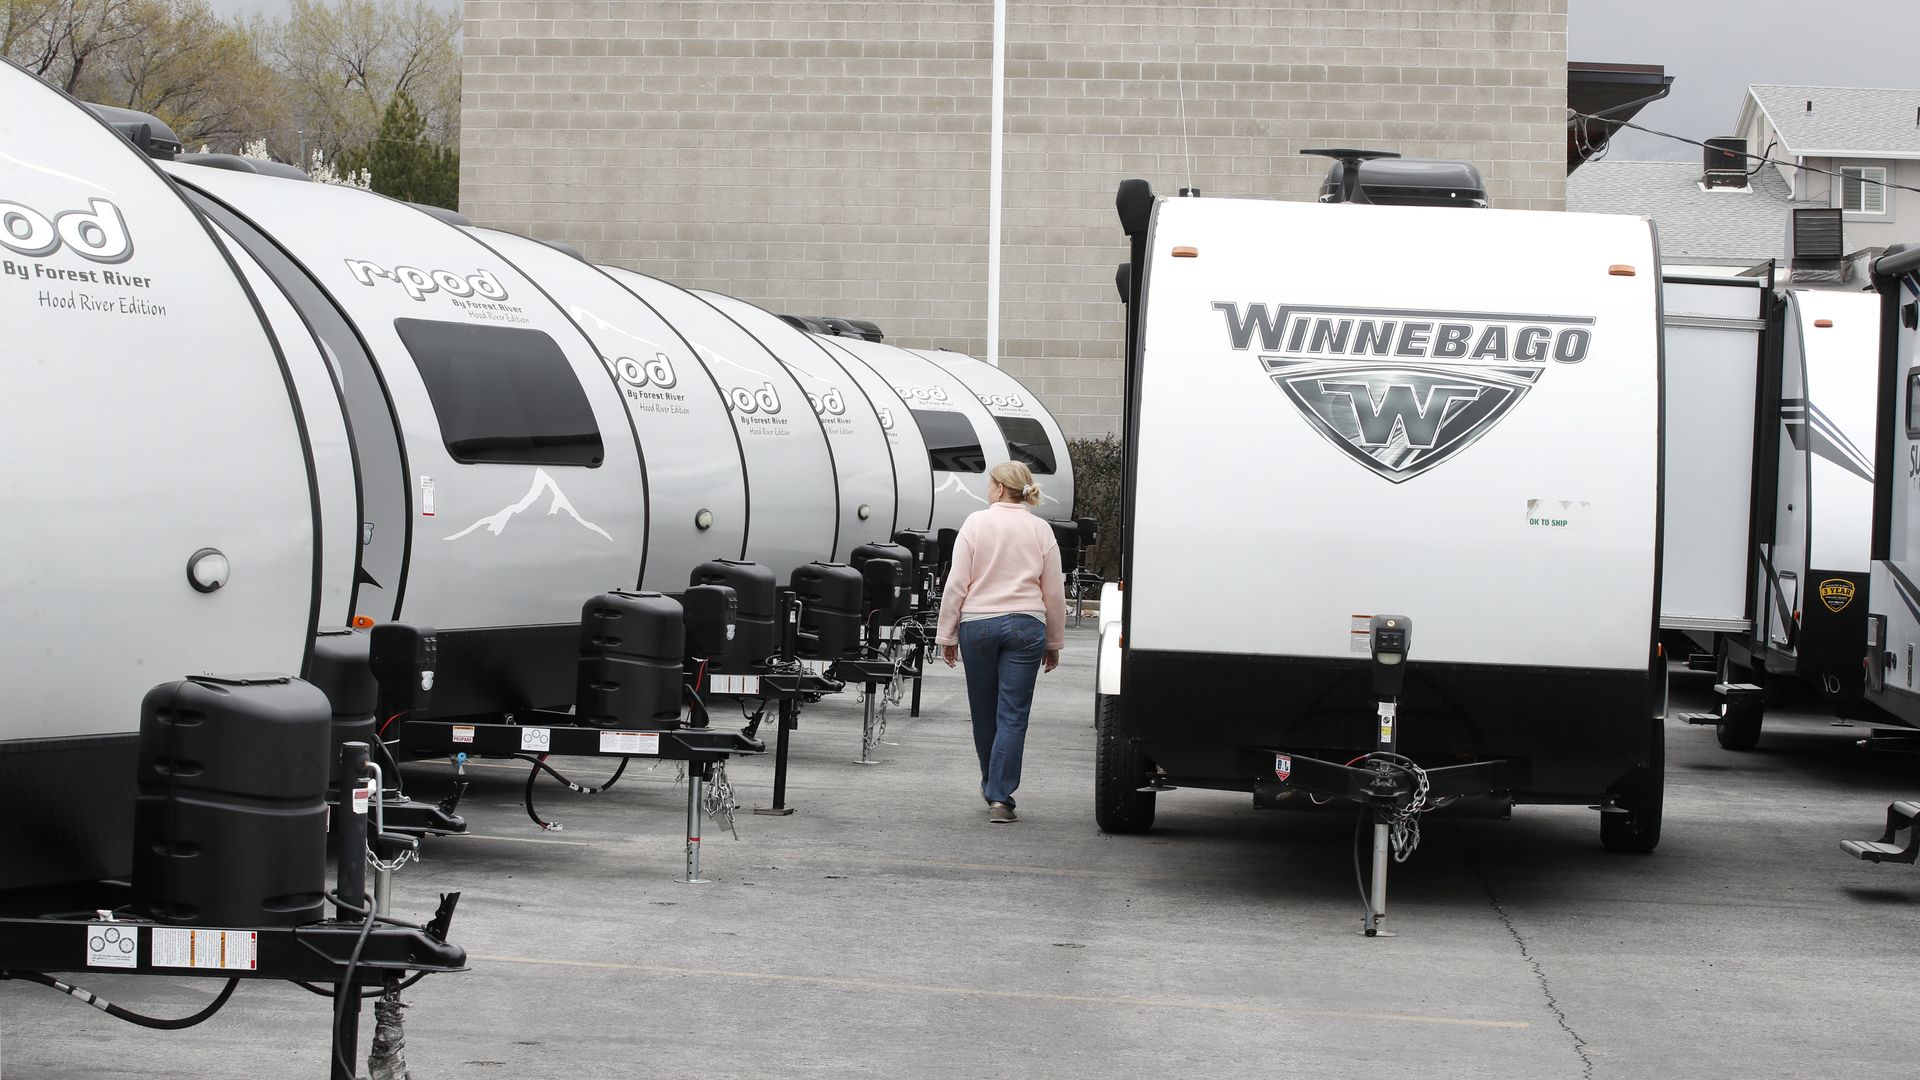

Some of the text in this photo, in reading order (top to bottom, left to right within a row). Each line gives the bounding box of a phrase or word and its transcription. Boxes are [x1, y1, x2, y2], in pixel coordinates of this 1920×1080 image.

[3, 260, 152, 288] By Forest River
[38, 290, 167, 316] Hood River Edition
[451, 298, 522, 313] By Forest River
[468, 310, 487, 320] Hood
[1211, 301, 1597, 364] WINNEBAGO
[602, 352, 677, 390] od
[627, 389, 686, 402] By Forest River
[720, 381, 782, 415] od
[740, 416, 788, 425] By Forest River
[1317, 380, 1483, 448] W
[1529, 518, 1540, 526] OK
[1540, 519, 1550, 527] TO
[1830, 587, 1852, 596] YEAR
[1277, 759, 1289, 771] BL
